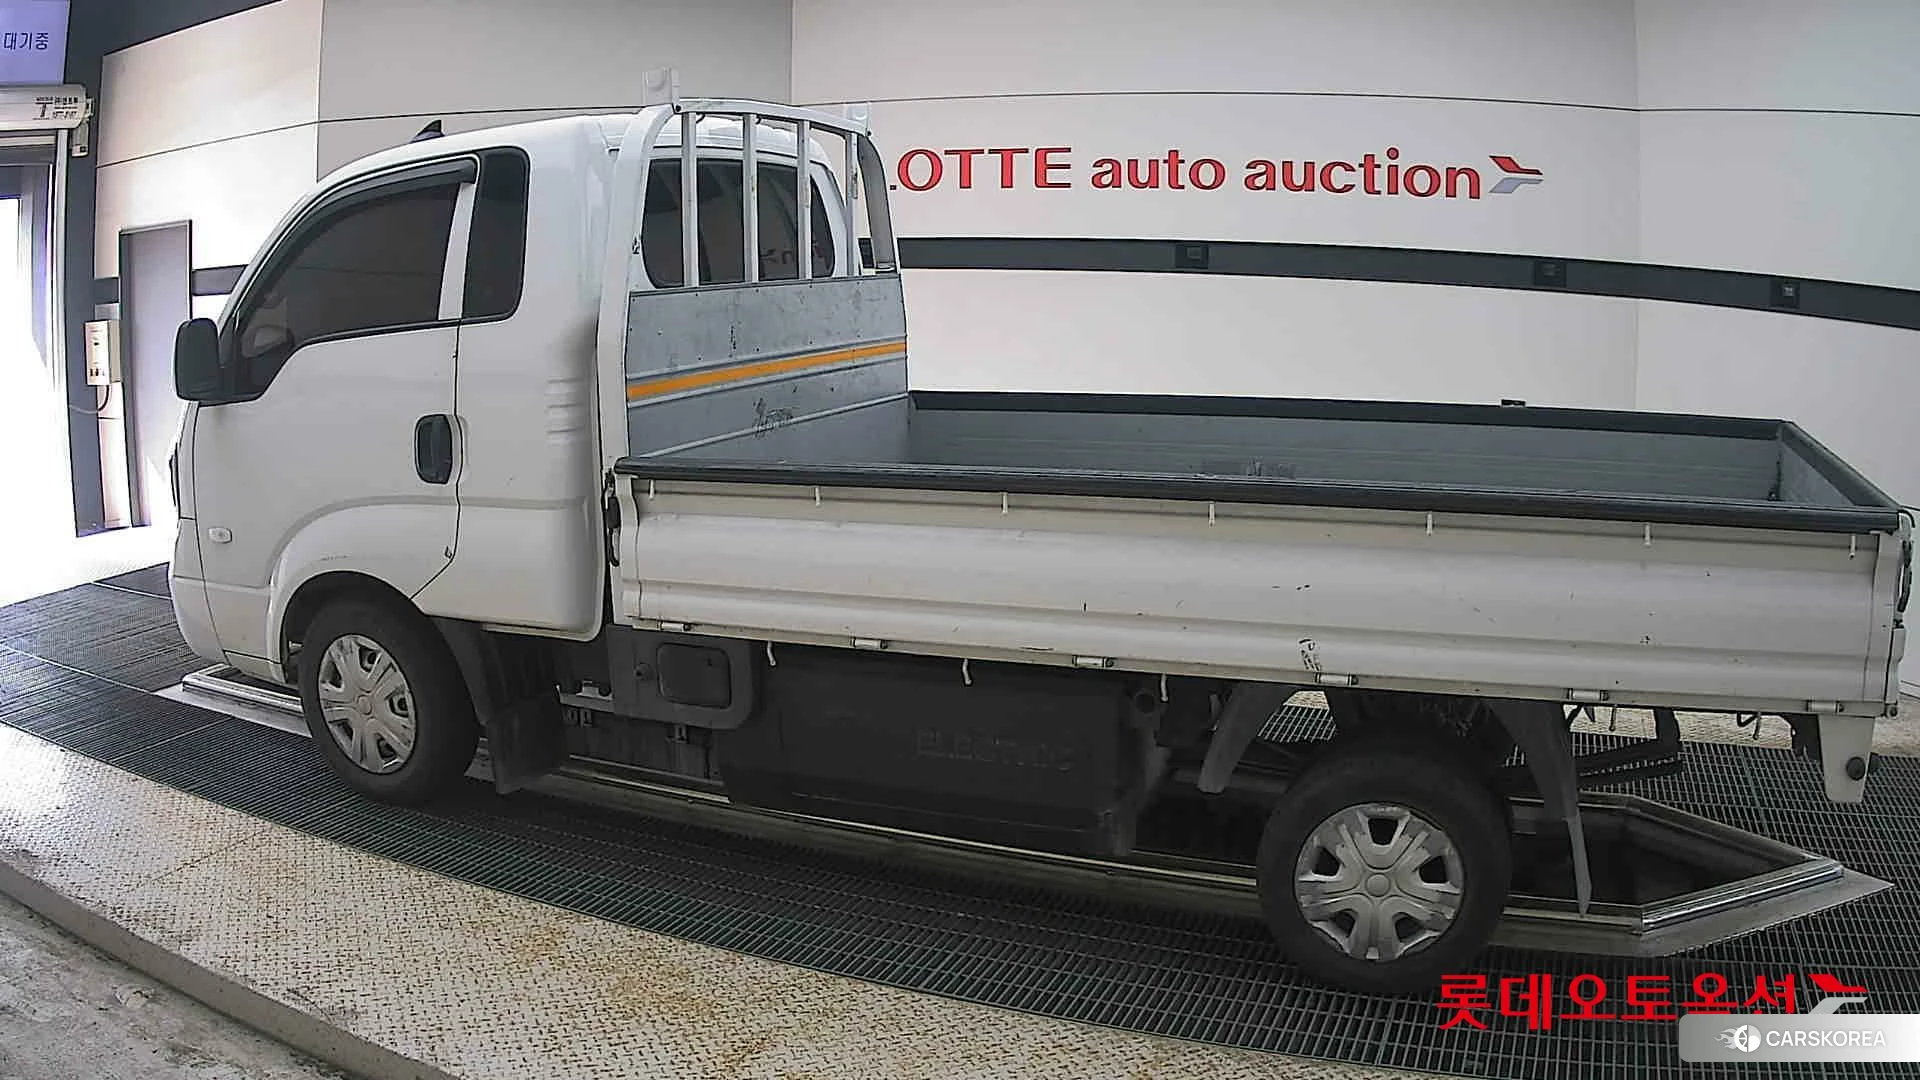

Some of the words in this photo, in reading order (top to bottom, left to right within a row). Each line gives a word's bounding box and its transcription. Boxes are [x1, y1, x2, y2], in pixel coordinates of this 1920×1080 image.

[4, 32, 49, 50] 대기중
[890, 147, 1072, 192] OTTE
[1091, 149, 1226, 191] auto
[1244, 147, 1481, 200] auction
[912, 727, 1075, 773] ELECTC
